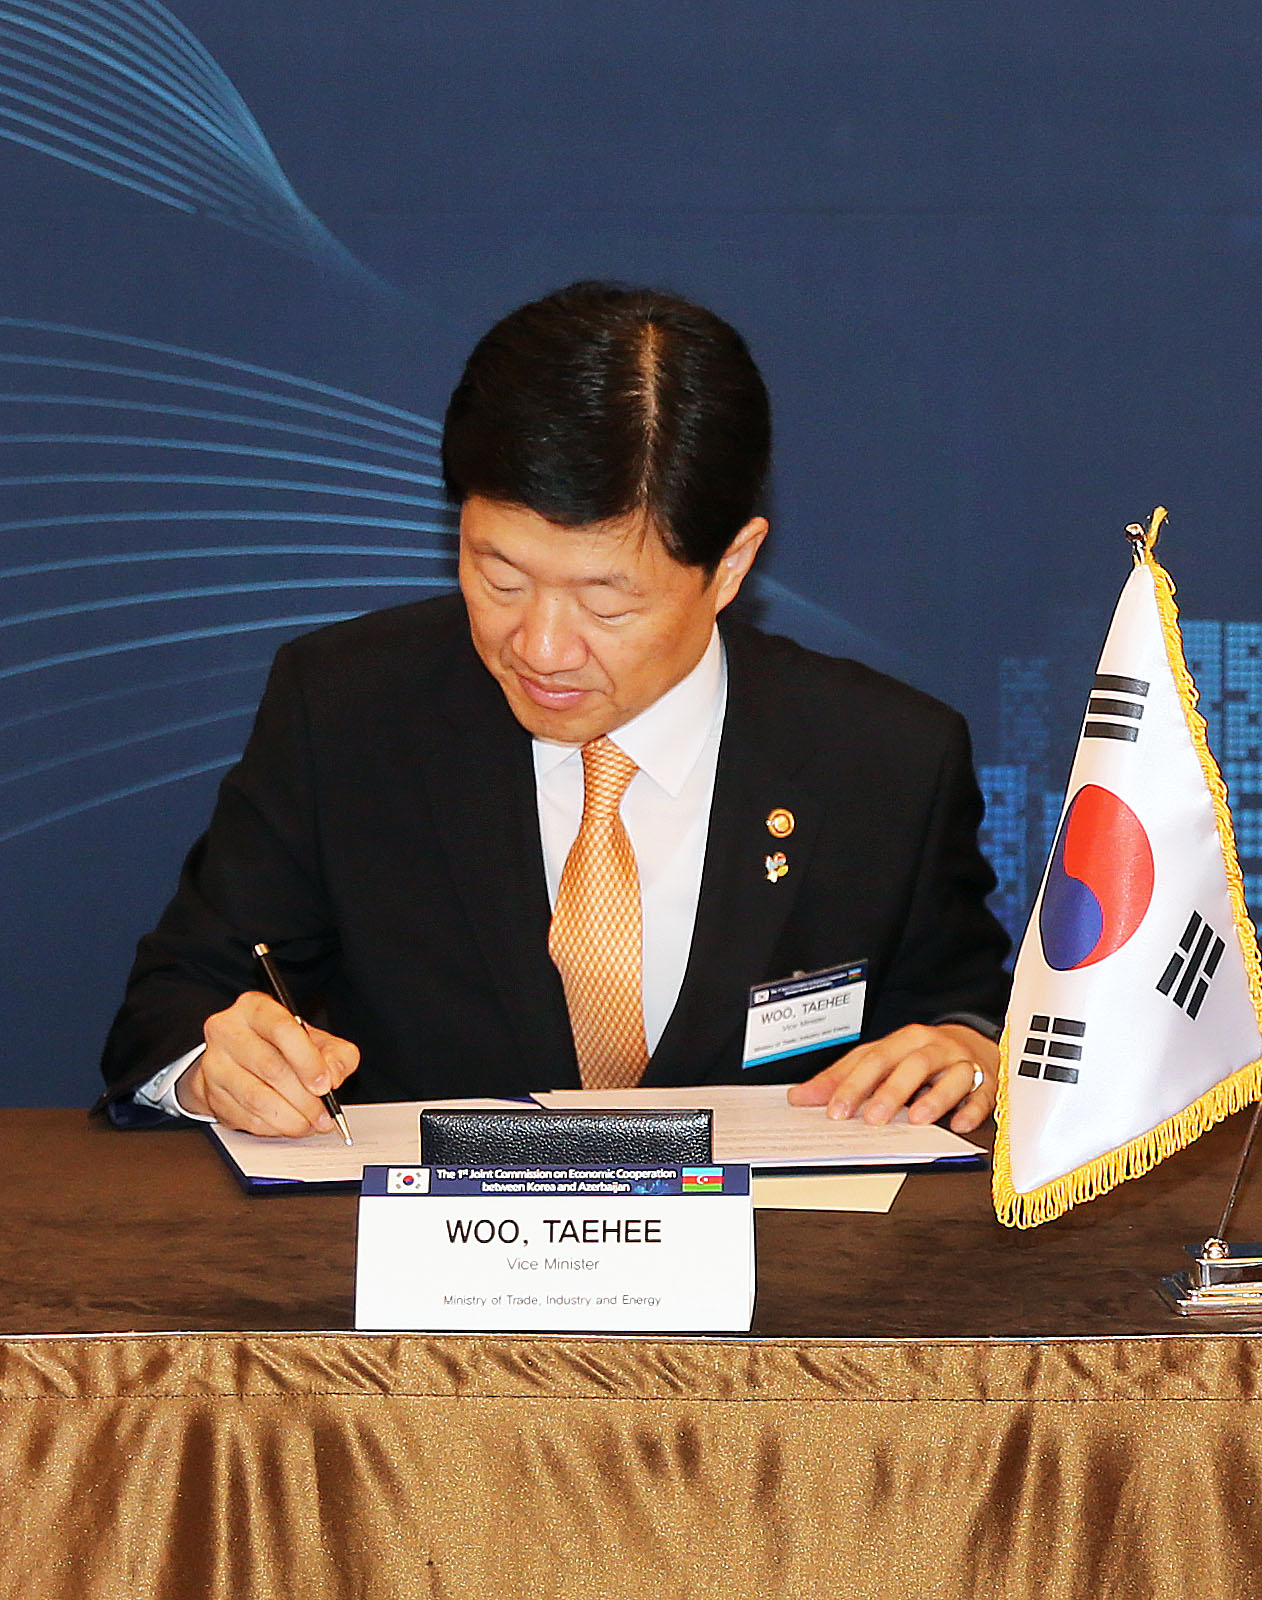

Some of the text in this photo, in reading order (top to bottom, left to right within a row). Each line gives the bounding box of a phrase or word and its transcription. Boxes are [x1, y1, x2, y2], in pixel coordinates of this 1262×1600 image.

[802, 993, 851, 1014] TAEHEE
[436, 1168, 456, 1180] The
[469, 1168, 494, 1180] Joint
[494, 1168, 553, 1180] Commission
[553, 1170, 568, 1179] on
[568, 1168, 616, 1179] Economic
[616, 1168, 677, 1181] Cooperation
[481, 1181, 631, 1194] between Korea and Azerbaijan
[446, 1219, 662, 1247] WOO, TAEHEE
[506, 1257, 600, 1270] Vice Minister
[443, 1294, 662, 1307] Ministry of Trade, Industry and Energy
